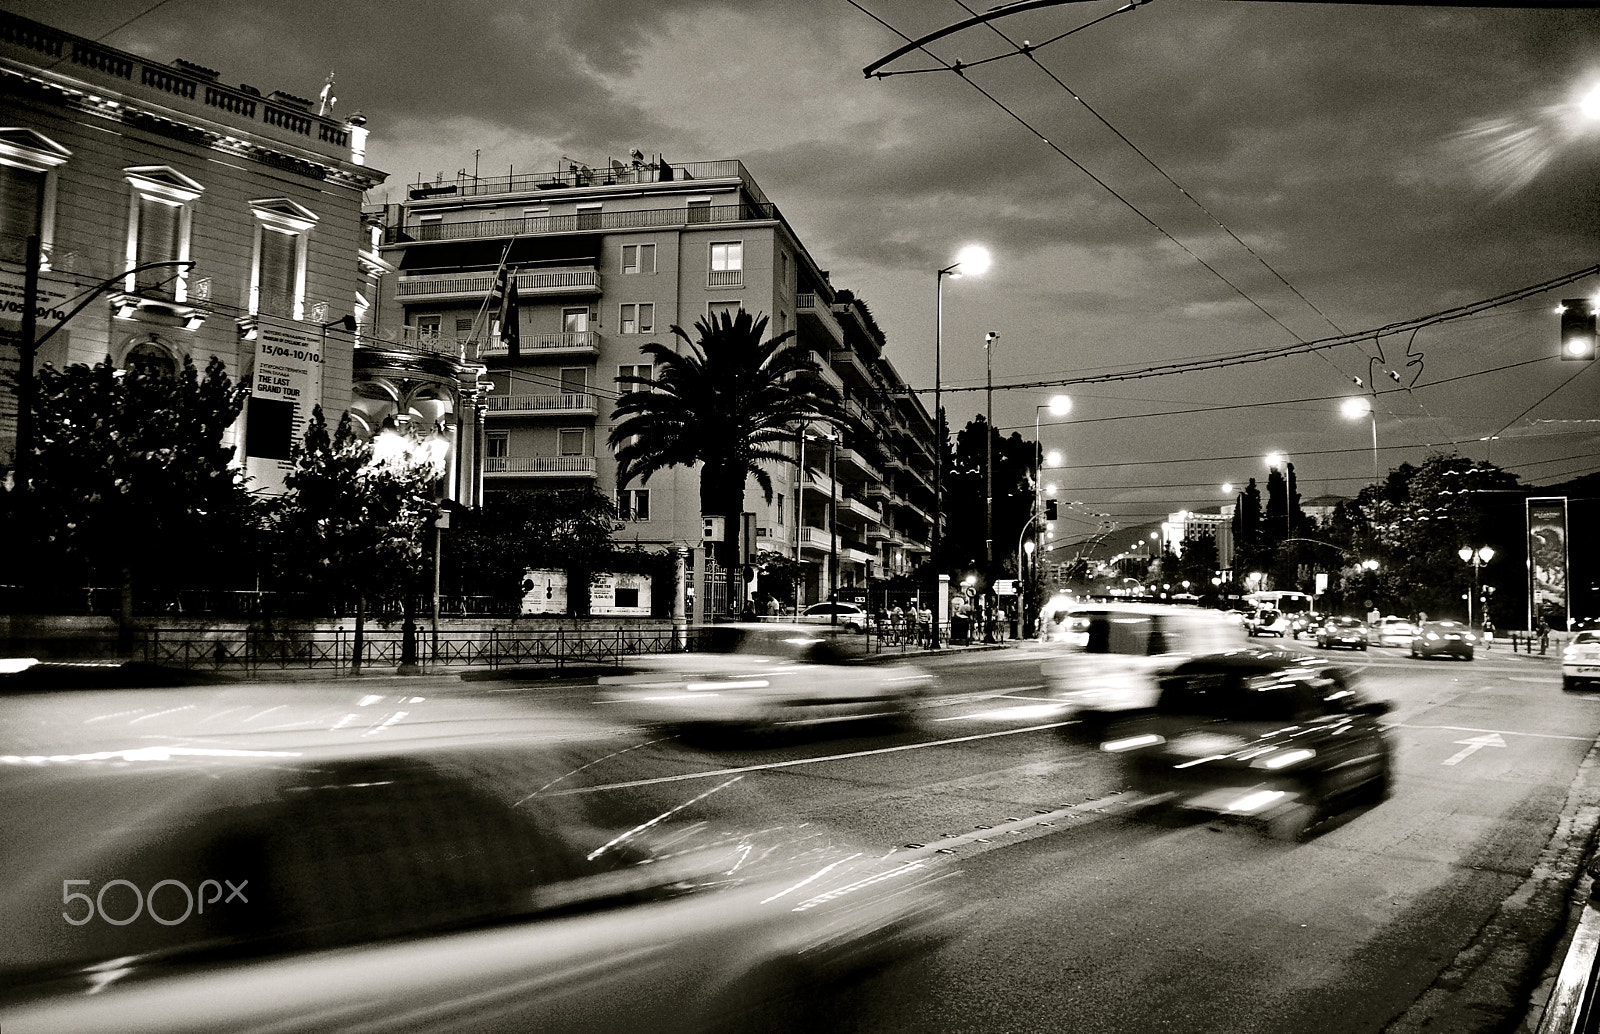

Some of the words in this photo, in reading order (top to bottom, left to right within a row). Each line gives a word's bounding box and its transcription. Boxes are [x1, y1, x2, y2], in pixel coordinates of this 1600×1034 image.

[262, 344, 320, 363] 15/04-10/10
[258, 374, 272, 384] THE
[273, 376, 290, 386] LAST
[257, 383, 281, 394] GRAND
[283, 387, 300, 397] TOUR
